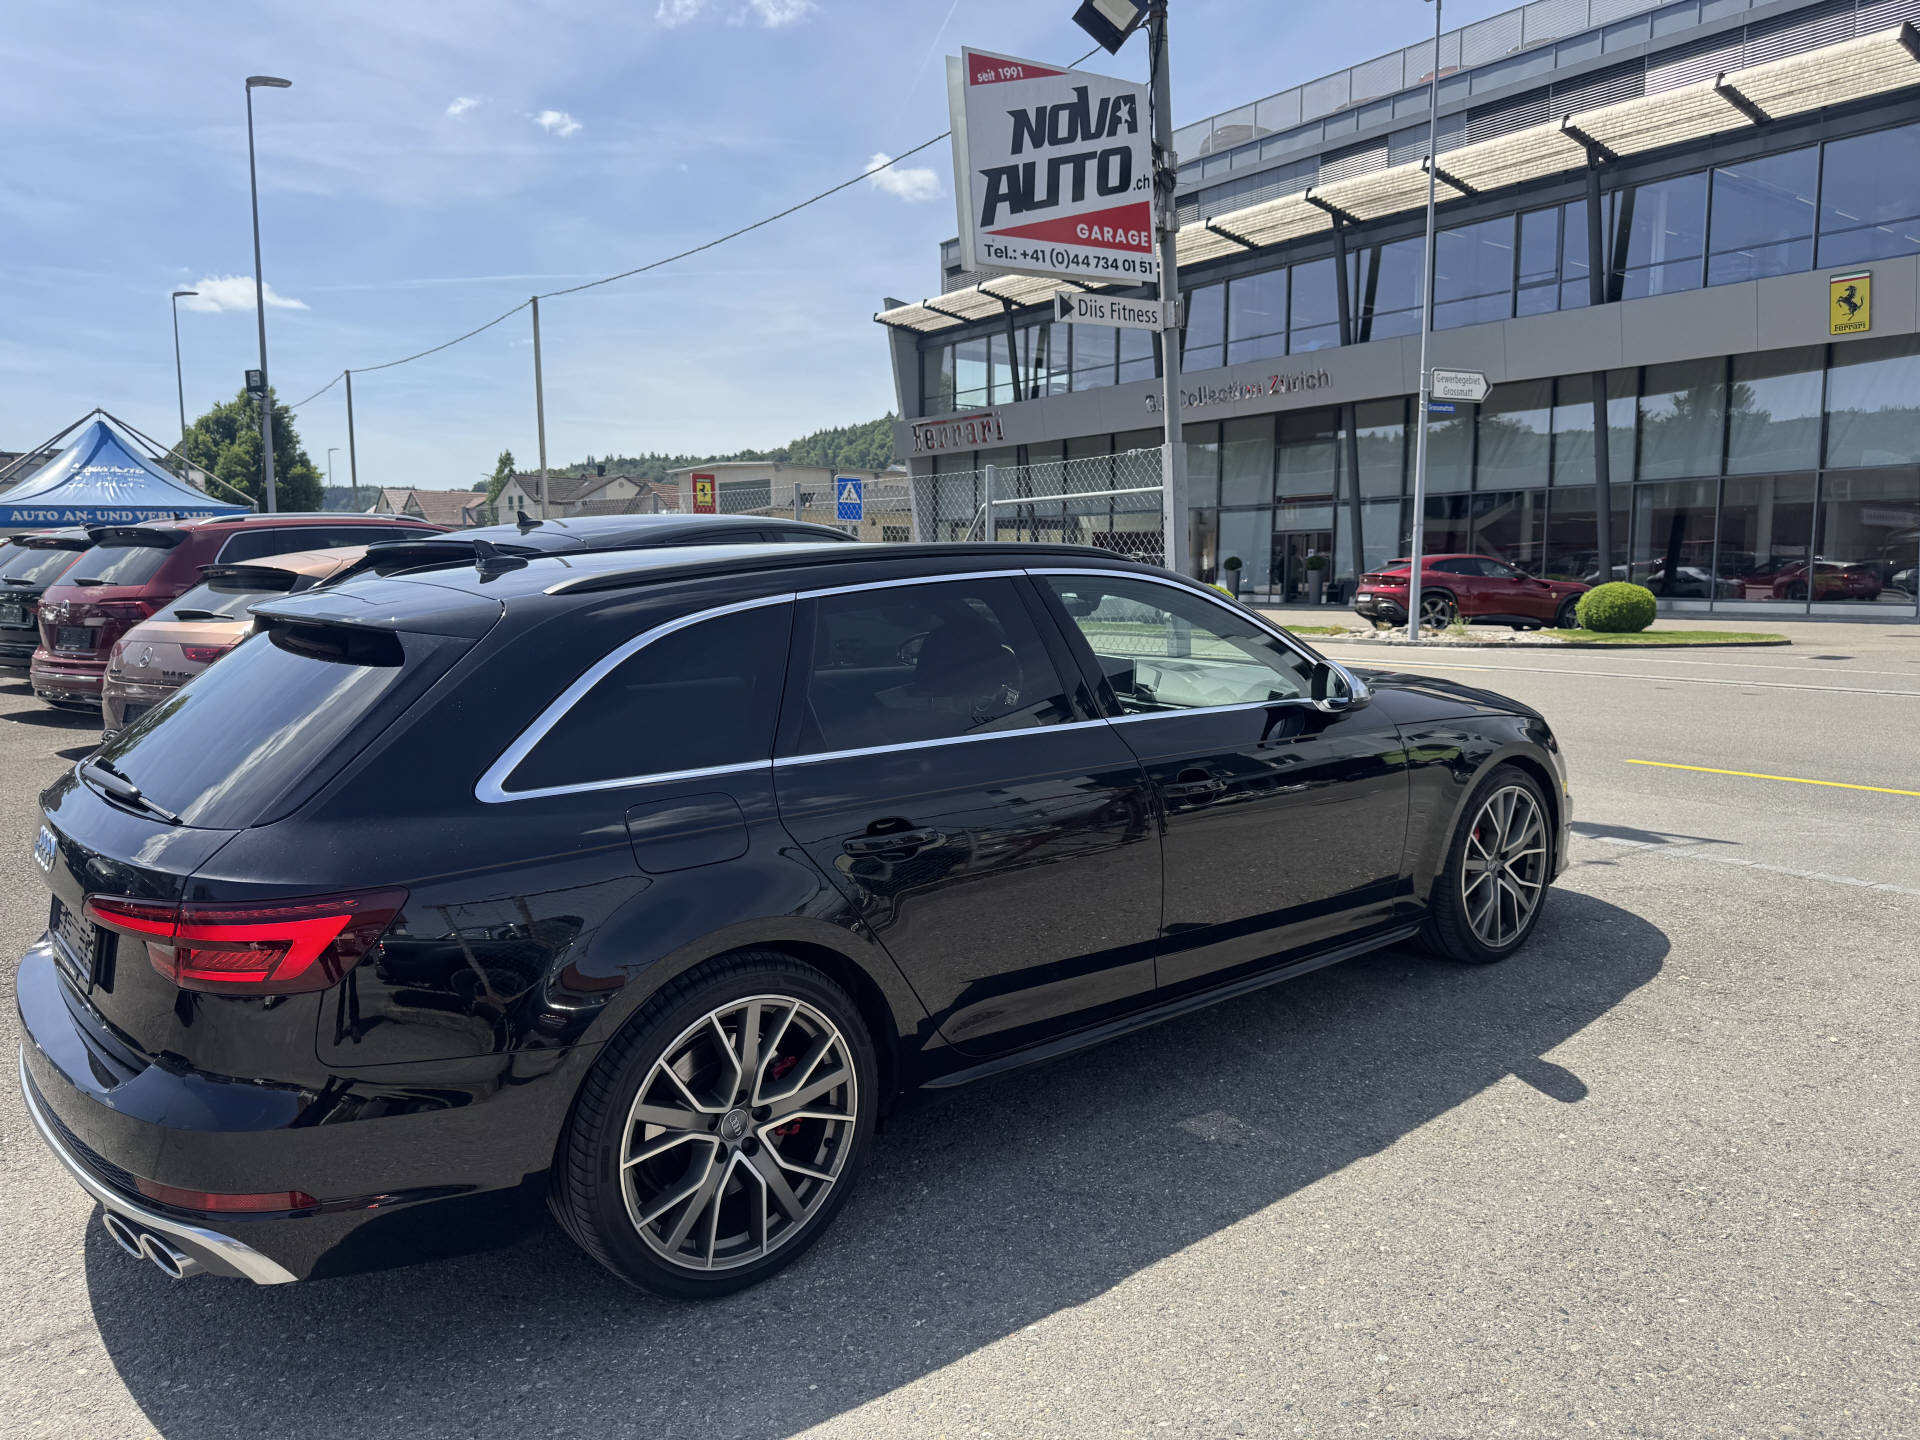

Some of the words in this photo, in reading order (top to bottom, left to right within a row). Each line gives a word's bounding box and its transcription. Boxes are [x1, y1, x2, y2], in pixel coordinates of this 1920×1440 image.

[977, 69, 995, 82] seit
[998, 66, 1023, 80] 1991
[1006, 85, 1138, 155] NOVA
[978, 145, 1132, 228] AUTO
[1076, 223, 1149, 247] GARAGE
[984, 244, 1017, 260] Tel.:
[1020, 249, 1046, 263] +41
[1093, 256, 1119, 272] 734
[1122, 259, 1136, 273] 01
[1139, 261, 1153, 274] 51
[1078, 298, 1105, 319] Diis
[1110, 302, 1158, 323] Fitness
[1834, 321, 1866, 332] Ferrari
[1268, 368, 1331, 395] Zürich
[1435, 373, 1481, 386] Gewerbegebiet
[910, 411, 1004, 452] Ferrari
[10, 510, 59, 521] AUTO
[62, 510, 93, 521] AN-
[95, 511, 133, 521] UND
